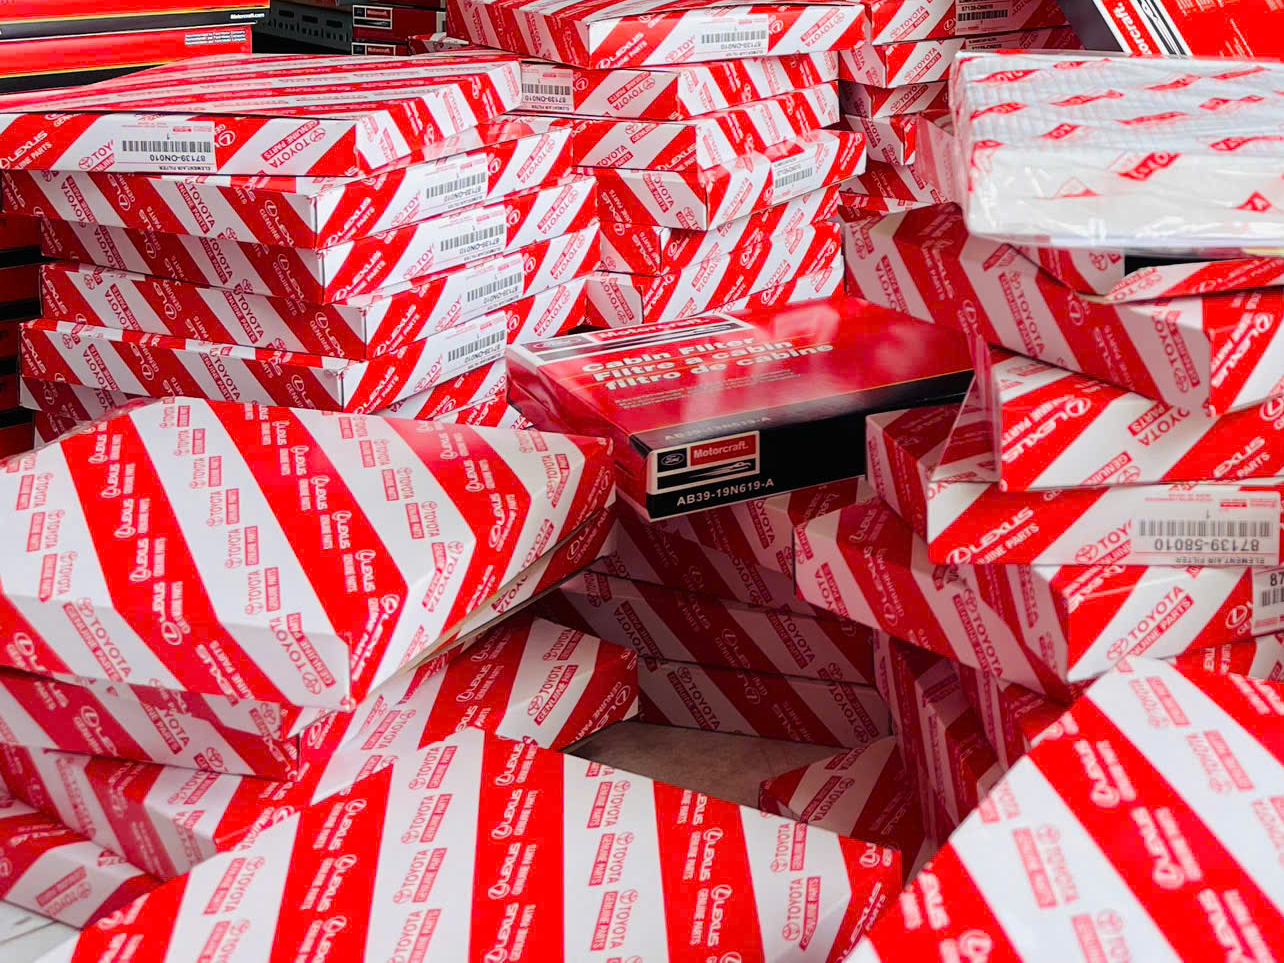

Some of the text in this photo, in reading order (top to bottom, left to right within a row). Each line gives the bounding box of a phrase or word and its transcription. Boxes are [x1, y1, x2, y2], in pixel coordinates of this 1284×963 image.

[608, 31, 645, 62] LEXUS
[612, 83, 643, 111] TOYOTA
[10, 130, 49, 161] LEXUS
[268, 137, 313, 168] TOYOTA
[339, 197, 372, 239] LEXUS
[238, 292, 265, 339] TOYOTA
[582, 337, 755, 372] Cabin Filter
[592, 360, 676, 382] Filtre
[711, 341, 793, 360] cabin
[605, 371, 682, 390] filtro
[691, 363, 727, 375] de
[736, 344, 834, 367] cabine
[662, 452, 685, 467] Ford
[676, 478, 775, 507] AB39-19N619-A
[970, 505, 1035, 554] LEXUS
[1005, 523, 1040, 549] PARTS
[1154, 537, 1260, 552] 87139-58010
[1175, 557, 1205, 565] FILTER
[1128, 585, 1183, 640] TOYOTA
[89, 614, 132, 679] TOYOTA
[270, 616, 311, 674] TOYOTA
[538, 664, 563, 696] TOYOTA
[707, 899, 724, 947] LEXUS
